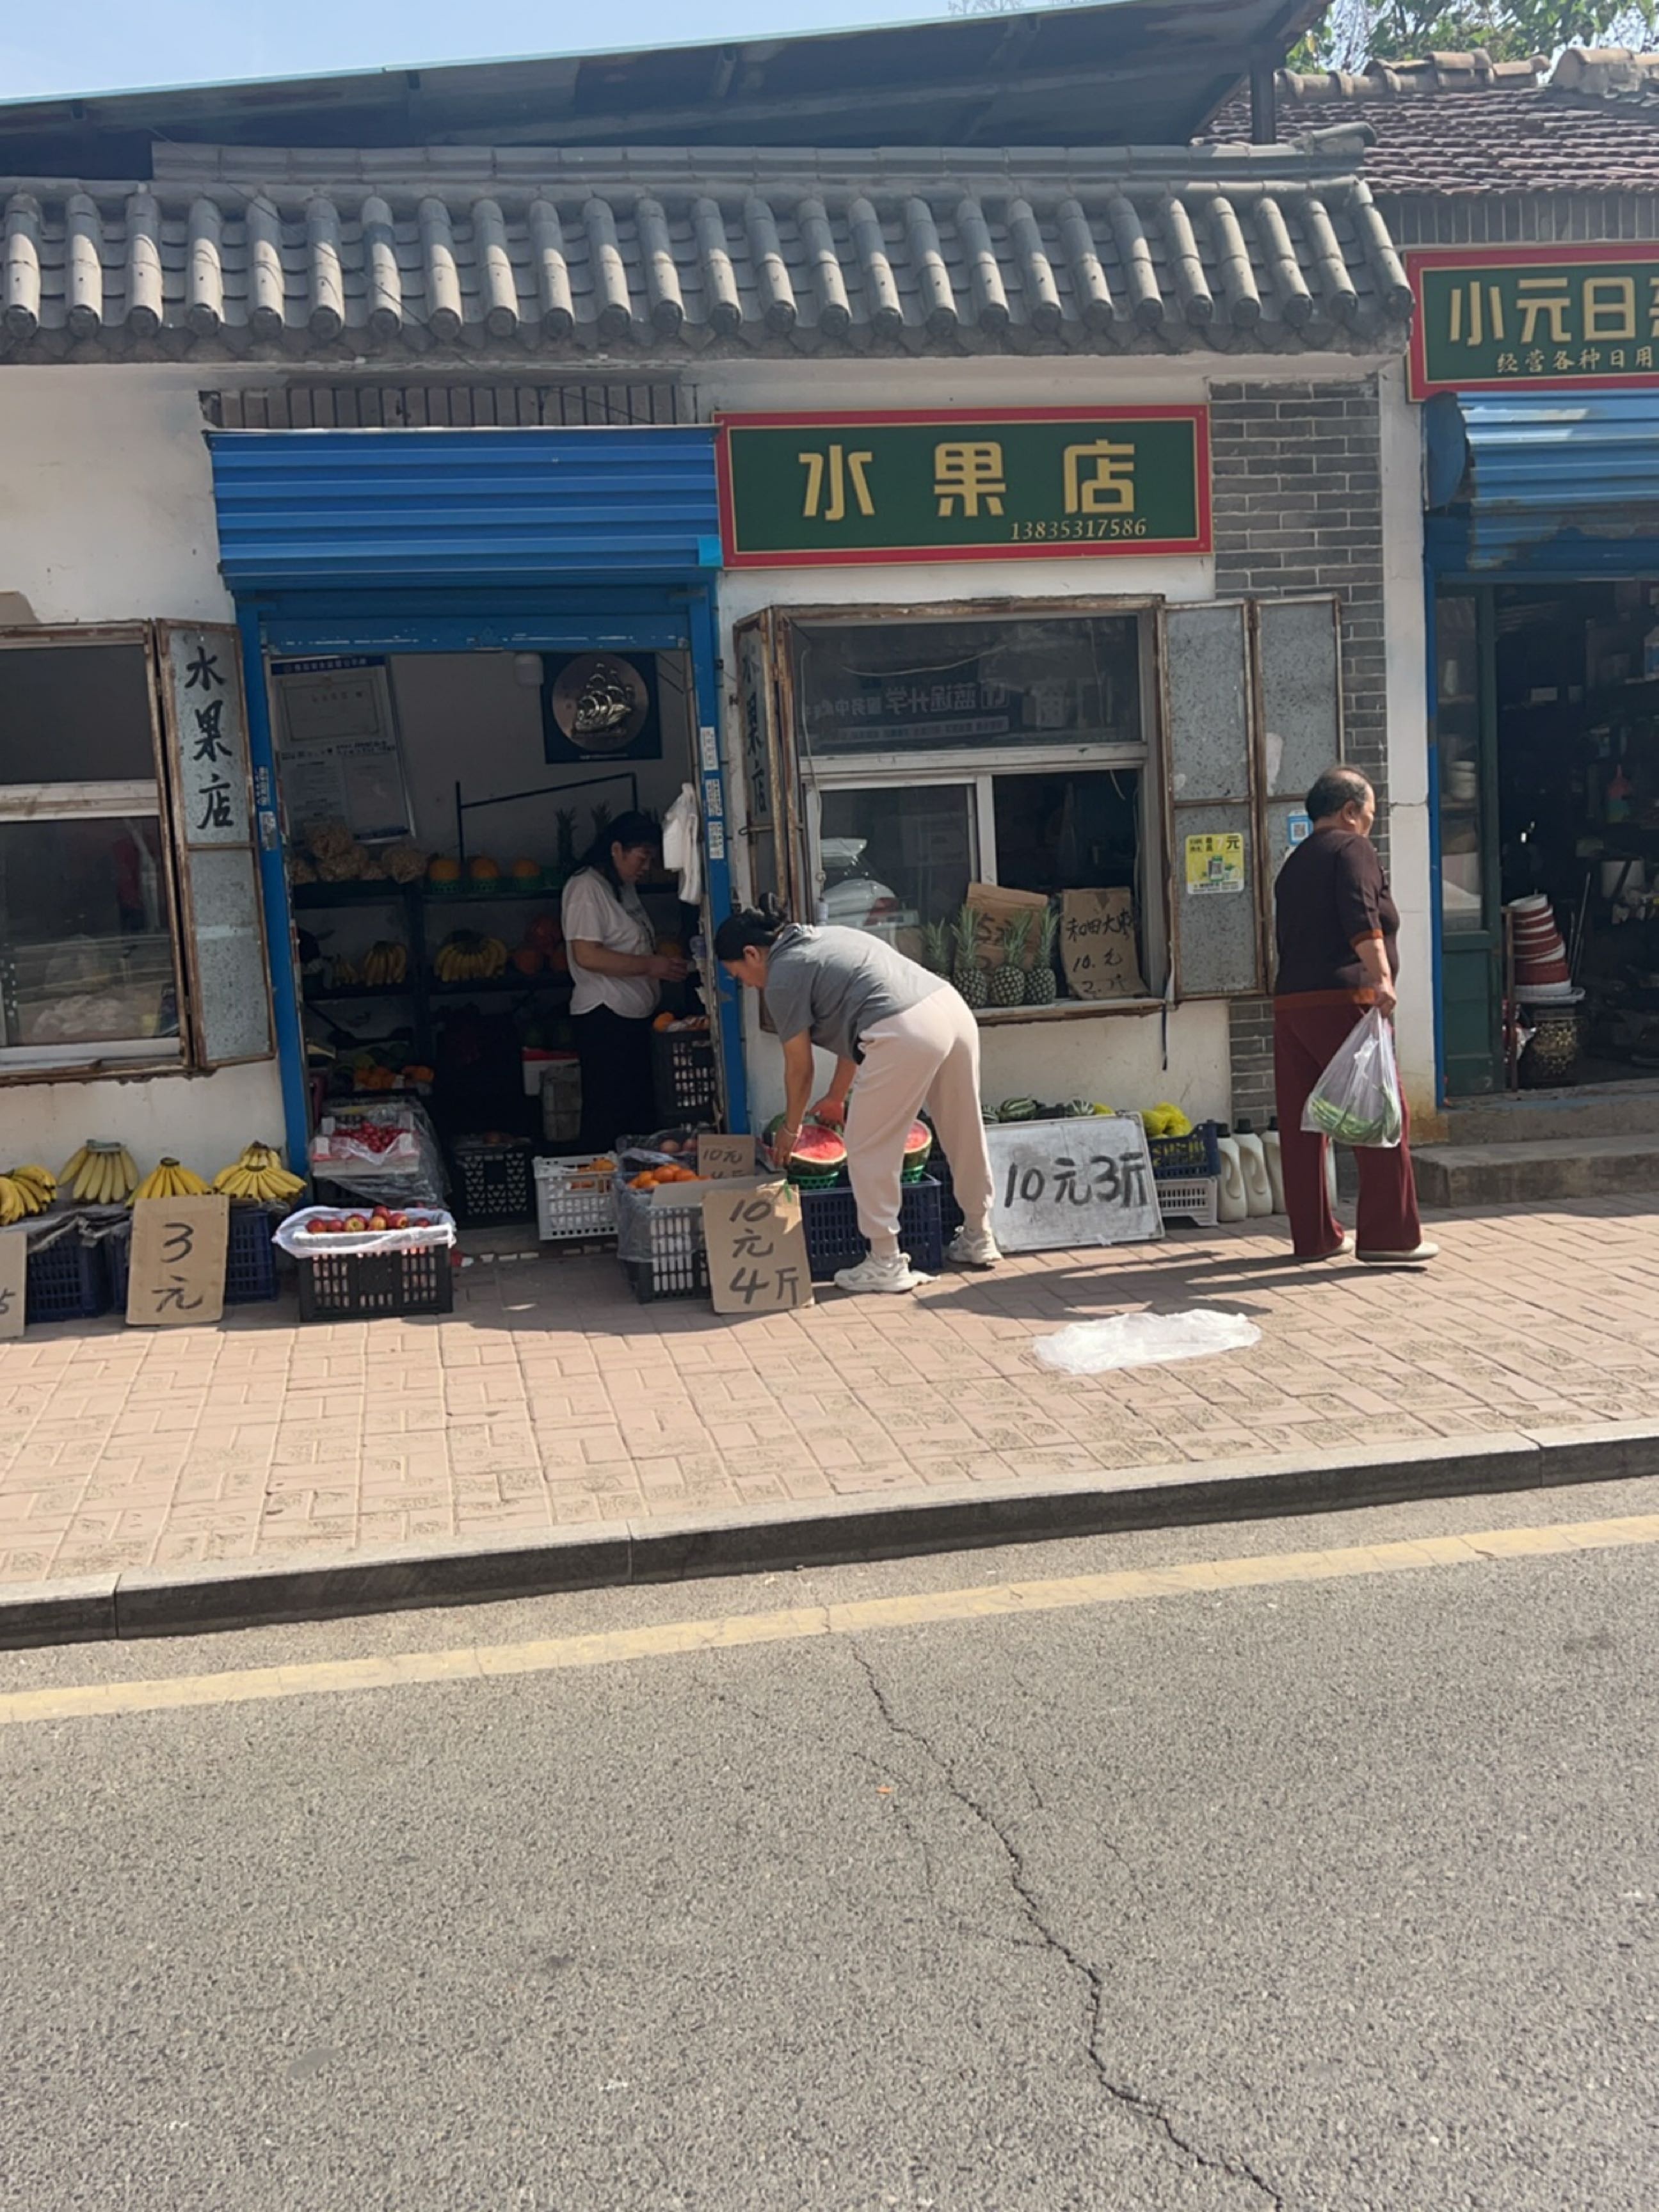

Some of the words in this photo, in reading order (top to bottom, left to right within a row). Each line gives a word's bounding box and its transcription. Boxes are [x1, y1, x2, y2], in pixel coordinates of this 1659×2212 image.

[1449, 276, 1659, 346] 小元日
[1497, 345, 1653, 373] 经营各种日用
[798, 439, 1135, 521] 水果店
[1010, 518, 1147, 540] 13835317586
[184, 646, 234, 829] 水果店
[729, 1199, 772, 1222] 10
[161, 1222, 194, 1263] 3
[732, 1229, 773, 1258] 元
[152, 1275, 203, 1312] 元
[729, 1267, 799, 1306] 4斤
